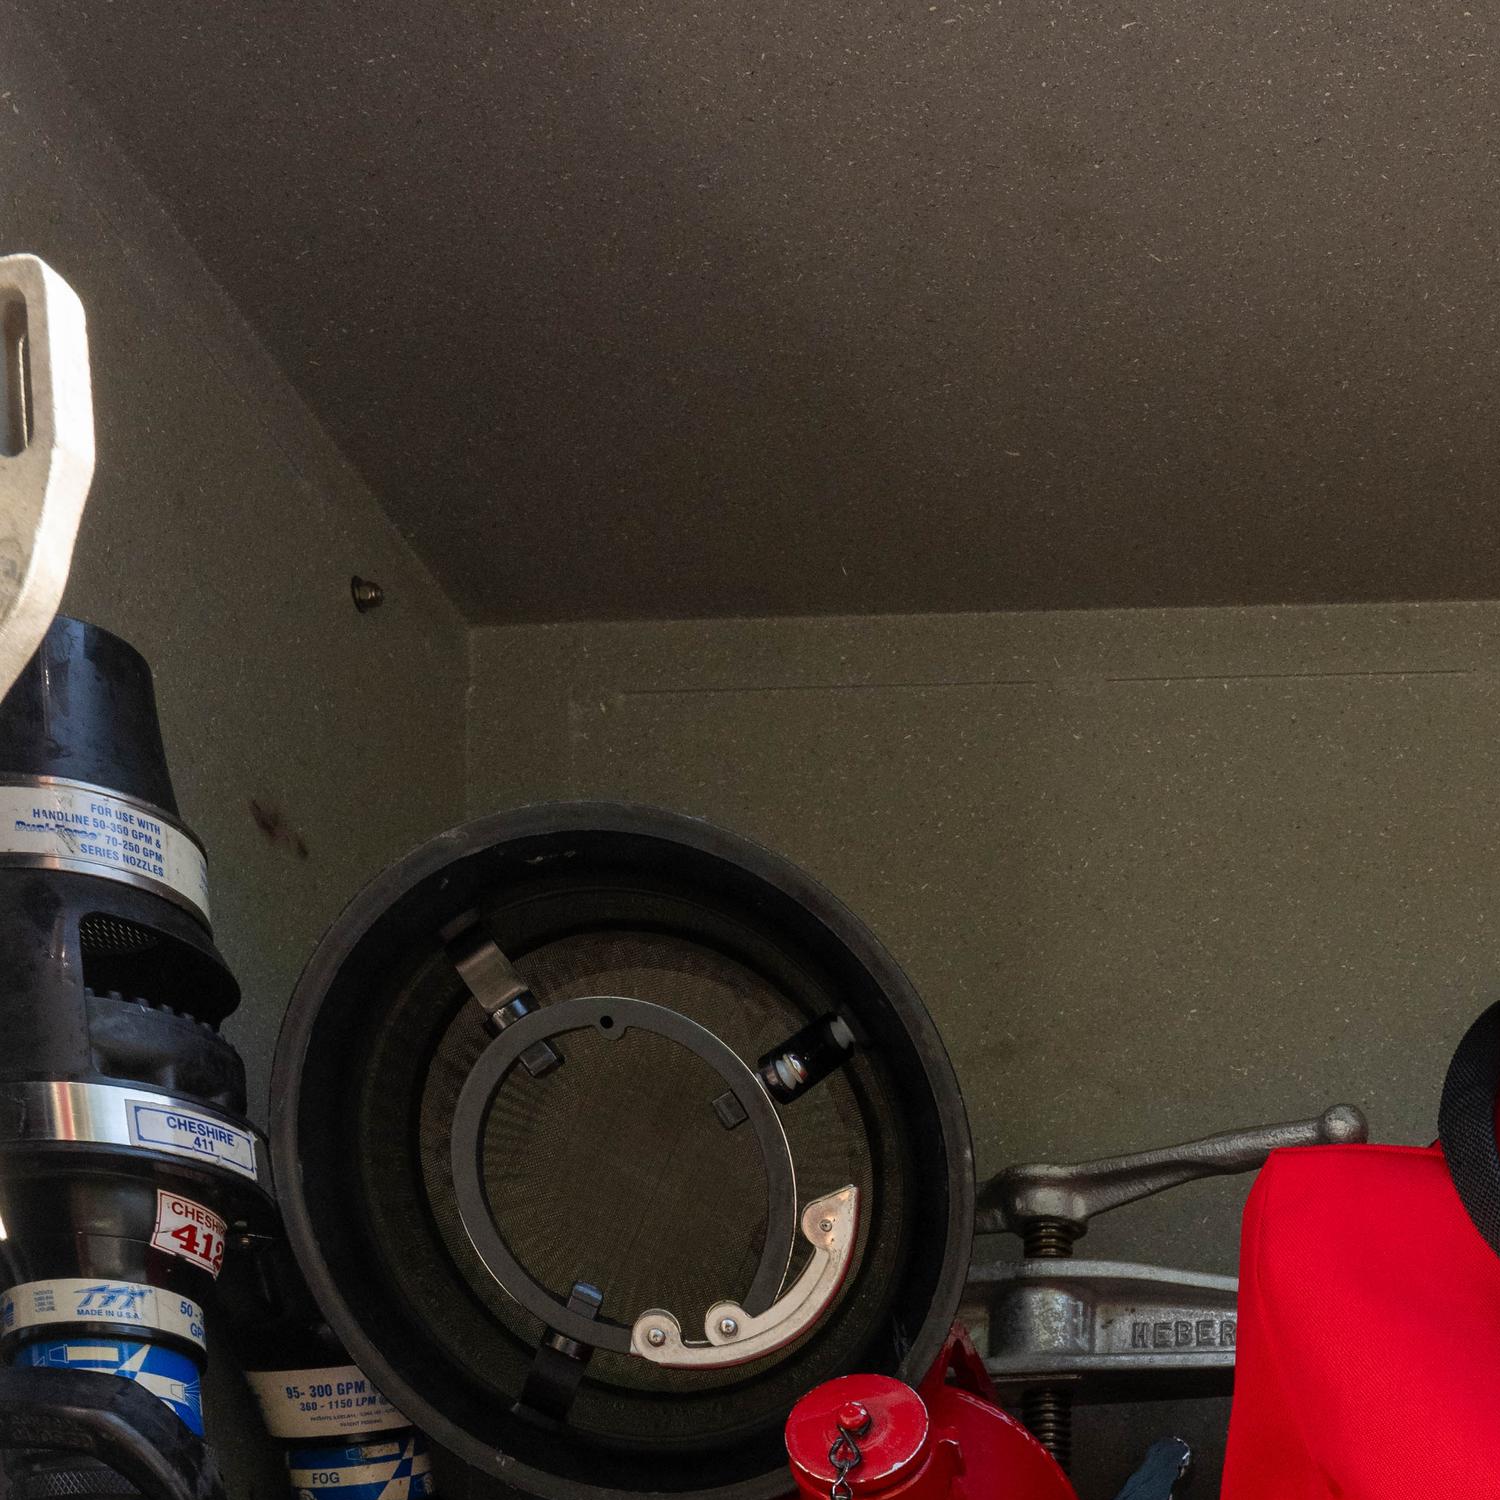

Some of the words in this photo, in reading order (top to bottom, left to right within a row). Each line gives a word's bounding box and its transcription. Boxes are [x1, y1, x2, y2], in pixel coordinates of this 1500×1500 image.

[32, 808, 90, 826] HANDLINE
[92, 818, 129, 837] 50-350
[131, 829, 153, 845] GPM
[155, 839, 162, 849] &
[91, 803, 112, 817] FOR
[115, 809, 135, 824] USE
[137, 818, 161, 835] WITH
[80, 843, 119, 861] SERIES
[123, 855, 164, 877] NOZZLES
[105, 836, 140, 854] 70-250
[143, 847, 163, 863] GPM
[166, 1116, 234, 1147] CHESHIRE
[193, 1136, 214, 1152] 411
[171, 1224, 225, 1271] 412
[77, 1308, 102, 1317] MADE
[105, 1309, 114, 1317] IN
[309, 1383, 333, 1398] 300
[336, 1380, 365, 1396] GPM
[300, 1400, 317, 1412] 360
[328, 1398, 353, 1410] 1150
[355, 1396, 377, 1408] LPM
[312, 1472, 340, 1485] FOG
